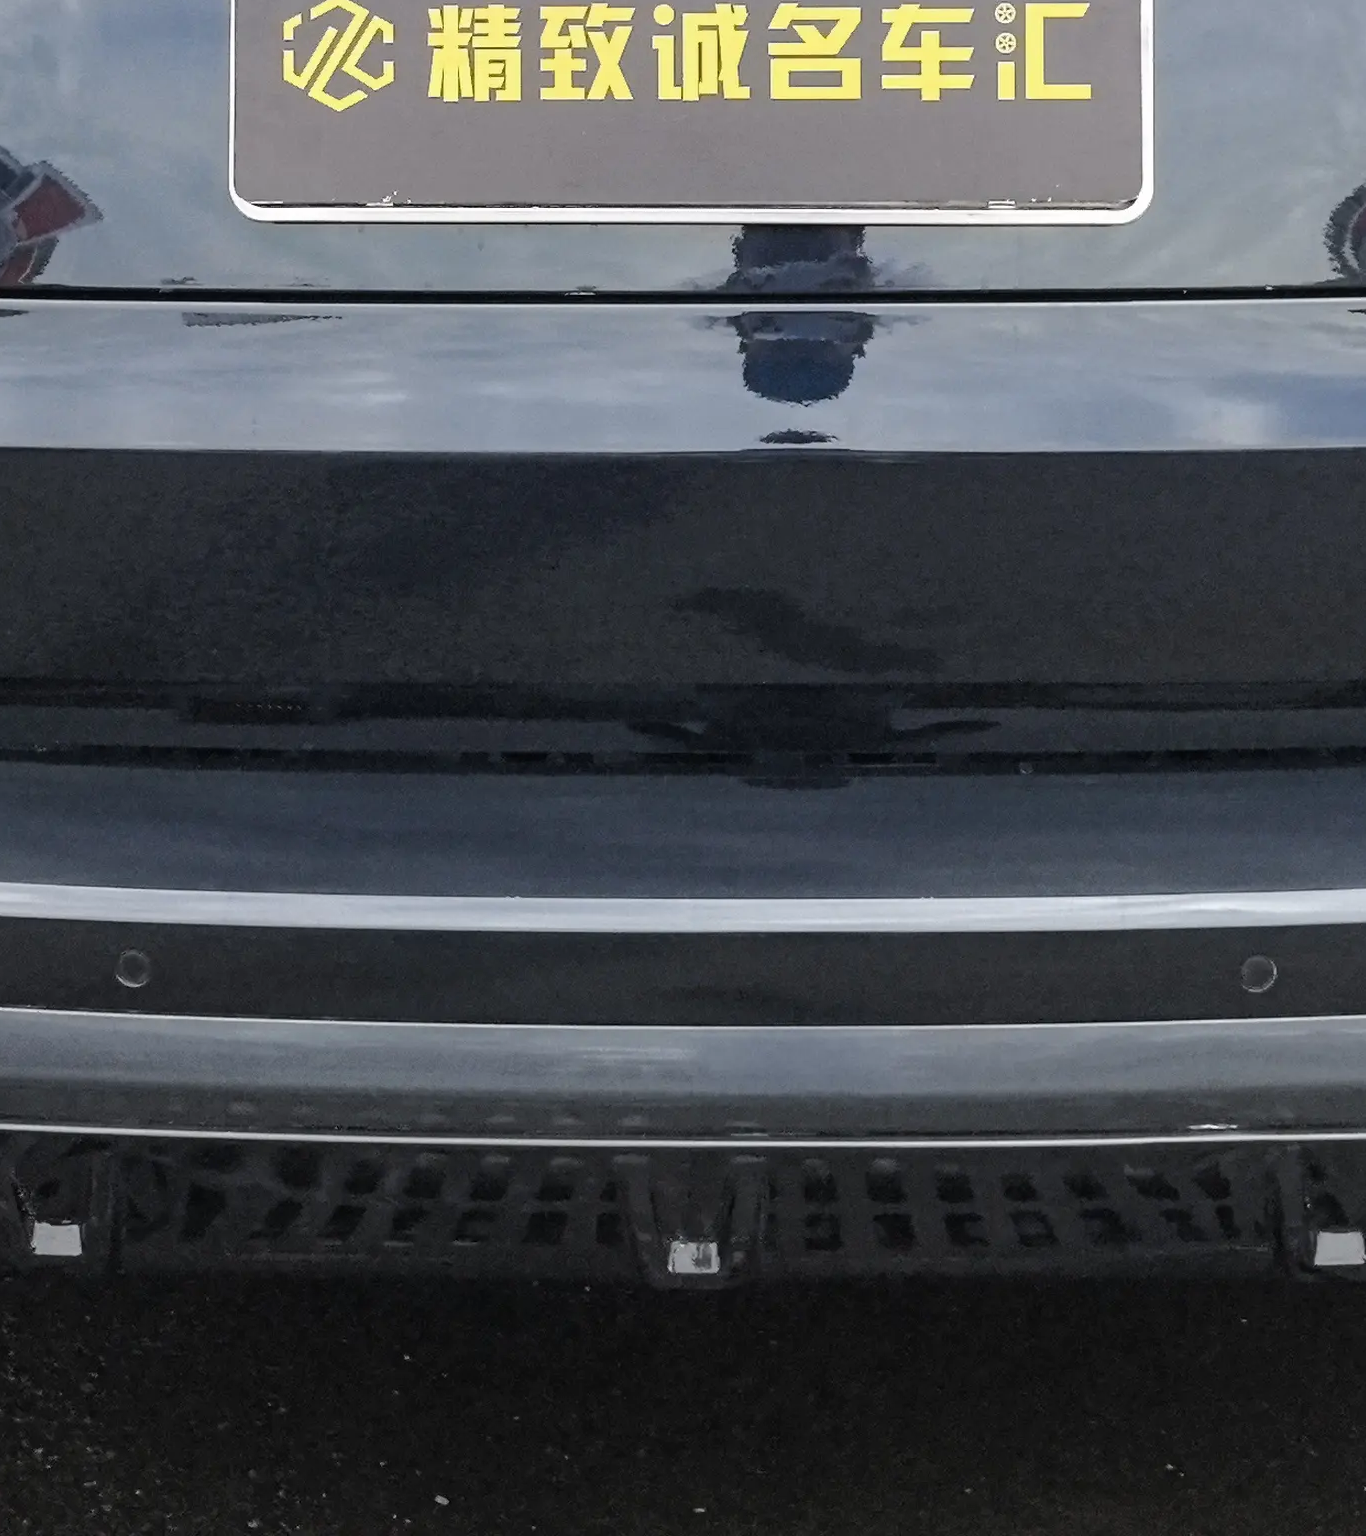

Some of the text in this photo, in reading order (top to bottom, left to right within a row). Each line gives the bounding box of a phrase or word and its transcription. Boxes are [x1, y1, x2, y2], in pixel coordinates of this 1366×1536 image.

[427, 3, 1092, 102] 精致诚名车汇
